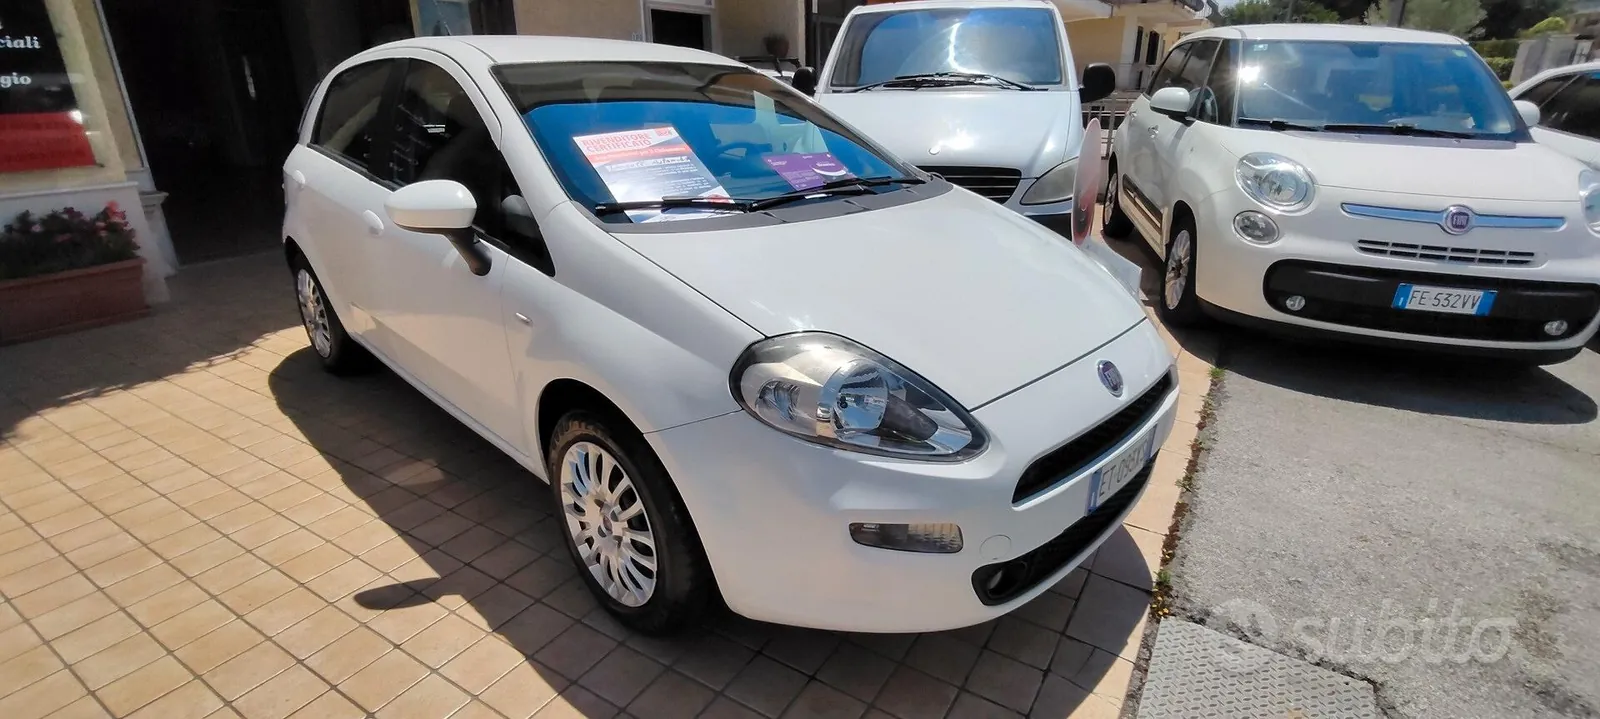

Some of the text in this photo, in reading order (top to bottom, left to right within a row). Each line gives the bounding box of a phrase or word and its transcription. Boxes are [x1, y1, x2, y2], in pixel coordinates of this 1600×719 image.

[581, 132, 652, 147] RIVENDITORE
[585, 140, 652, 153] CERTIFICATO
[1409, 290, 1481, 310] FE 532VV
